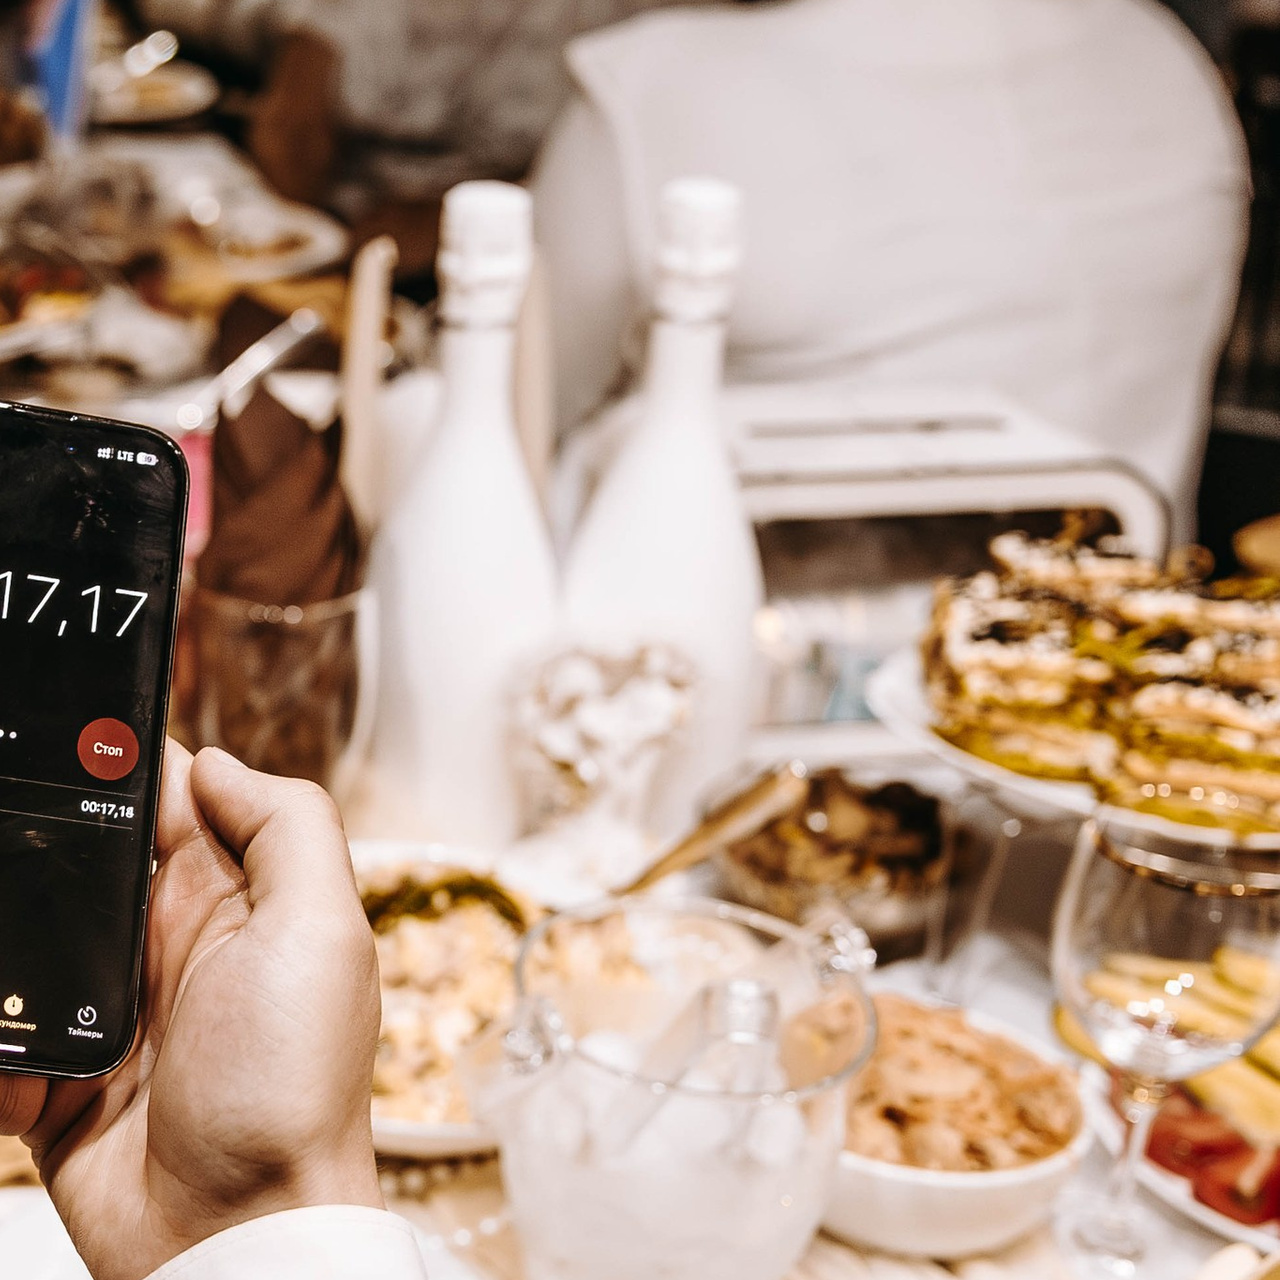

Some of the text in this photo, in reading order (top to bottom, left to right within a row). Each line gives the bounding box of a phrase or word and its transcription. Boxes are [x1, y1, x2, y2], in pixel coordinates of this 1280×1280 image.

[116, 450, 135, 462] LTE
[93, 741, 123, 758] Стоп
[67, 1026, 104, 1039] Таймеры
